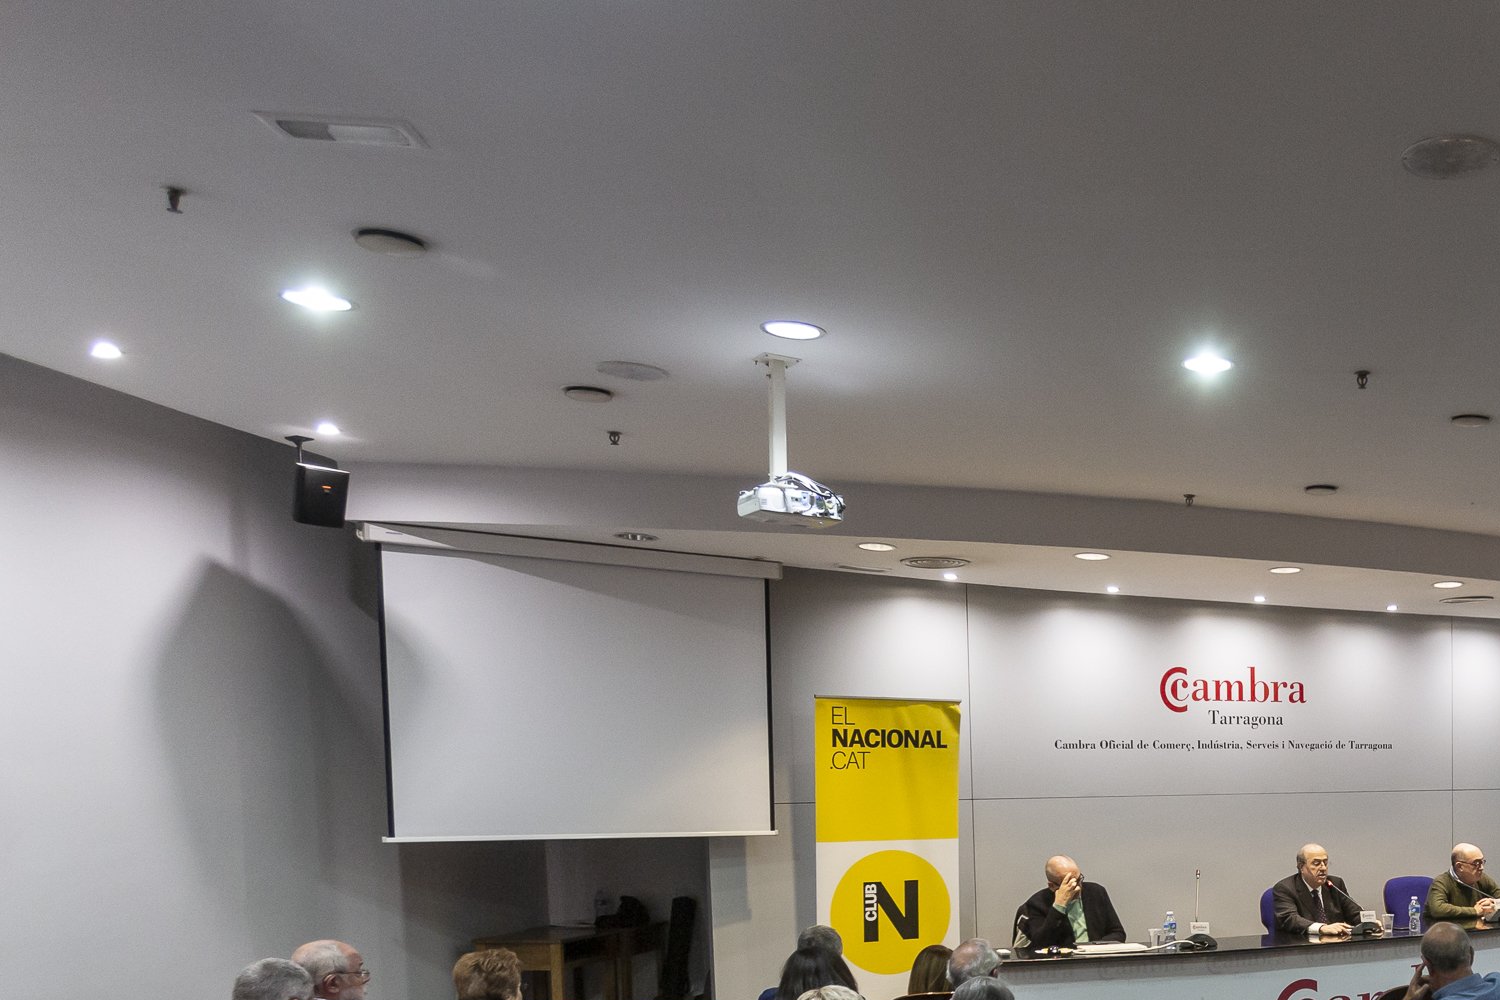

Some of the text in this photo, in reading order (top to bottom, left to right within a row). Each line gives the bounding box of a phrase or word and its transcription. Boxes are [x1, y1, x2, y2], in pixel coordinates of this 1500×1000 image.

[832, 706, 855, 725] EL
[1208, 709, 1283, 729] Tarragona
[832, 729, 947, 748] NACIONAL
[1054, 739, 1096, 750] Cambra
[1100, 739, 1133, 750] Oficial
[1137, 739, 1149, 750] de
[1152, 740, 1195, 752] Comerç,
[1197, 740, 1243, 751] Indústria,
[1246, 740, 1279, 750] Serveis
[1288, 740, 1333, 752] Navegació
[1335, 740, 1346, 750] de
[1348, 740, 1393, 752] Tarragona
[830, 751, 871, 770] .CAT
[863, 880, 919, 942] N
[865, 883, 878, 922] CLUB
